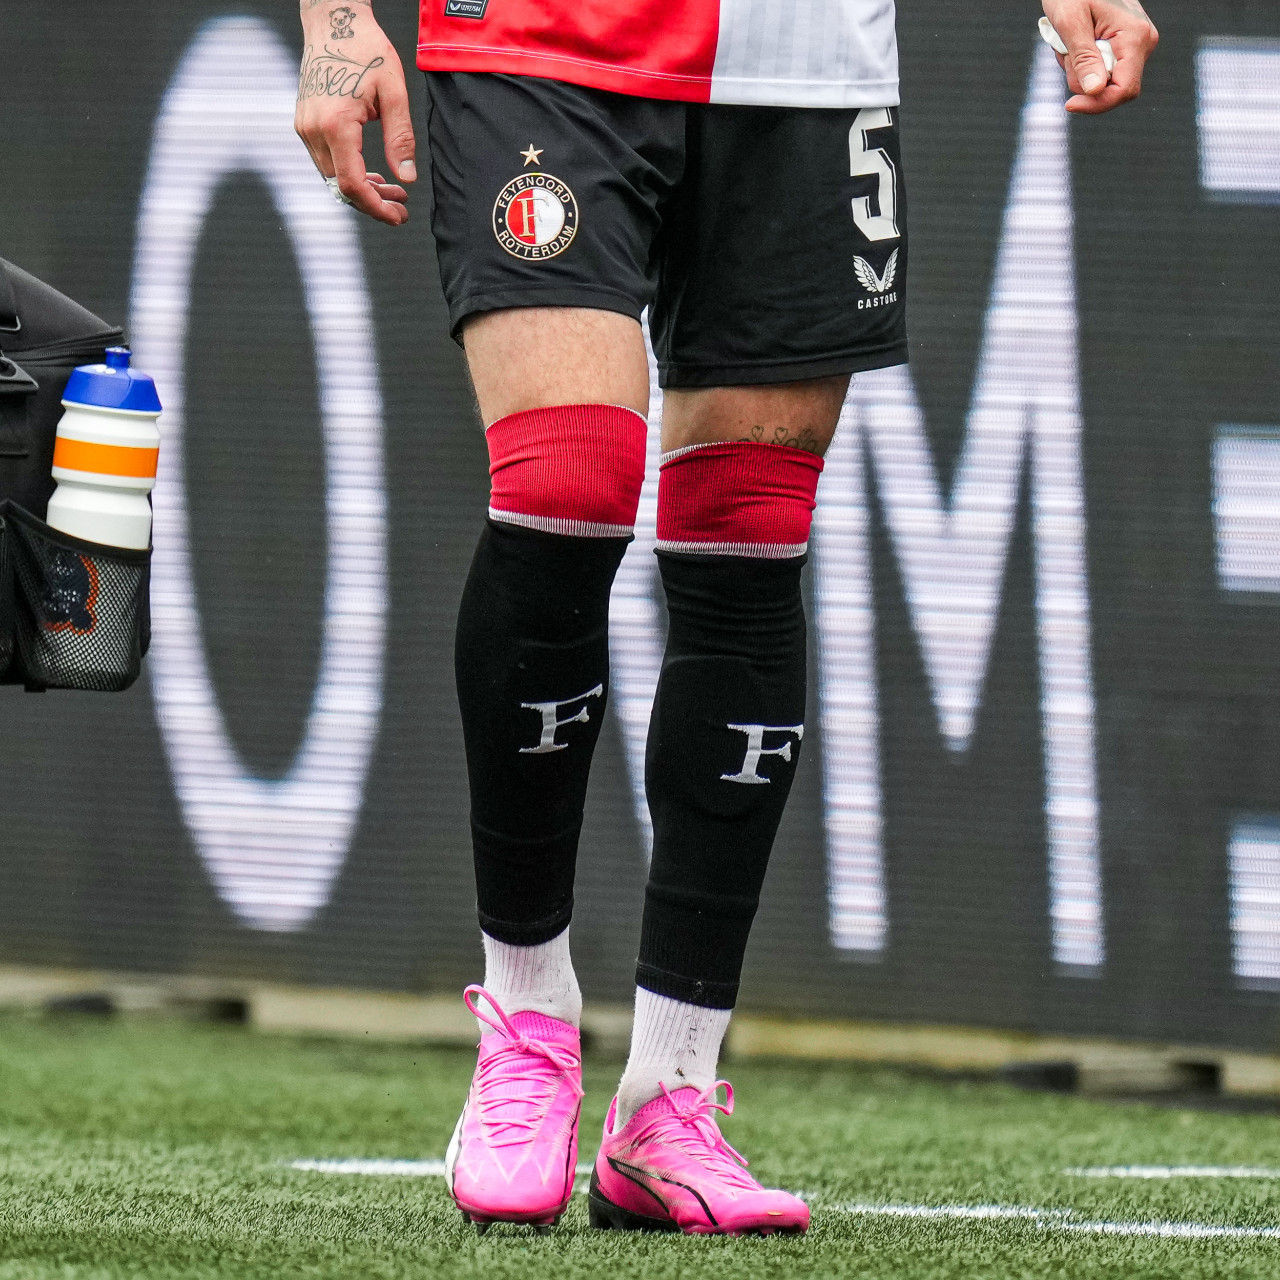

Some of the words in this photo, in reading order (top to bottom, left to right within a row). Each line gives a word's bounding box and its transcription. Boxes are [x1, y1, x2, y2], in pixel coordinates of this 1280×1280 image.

[498, 175, 571, 209] FEYENOORD
[848, 106, 901, 242] 5
[516, 197, 550, 237] F
[498, 224, 575, 258] ROTTERDAM
[857, 291, 898, 310] CASTORE
[519, 683, 604, 754] F
[720, 723, 804, 784] F
